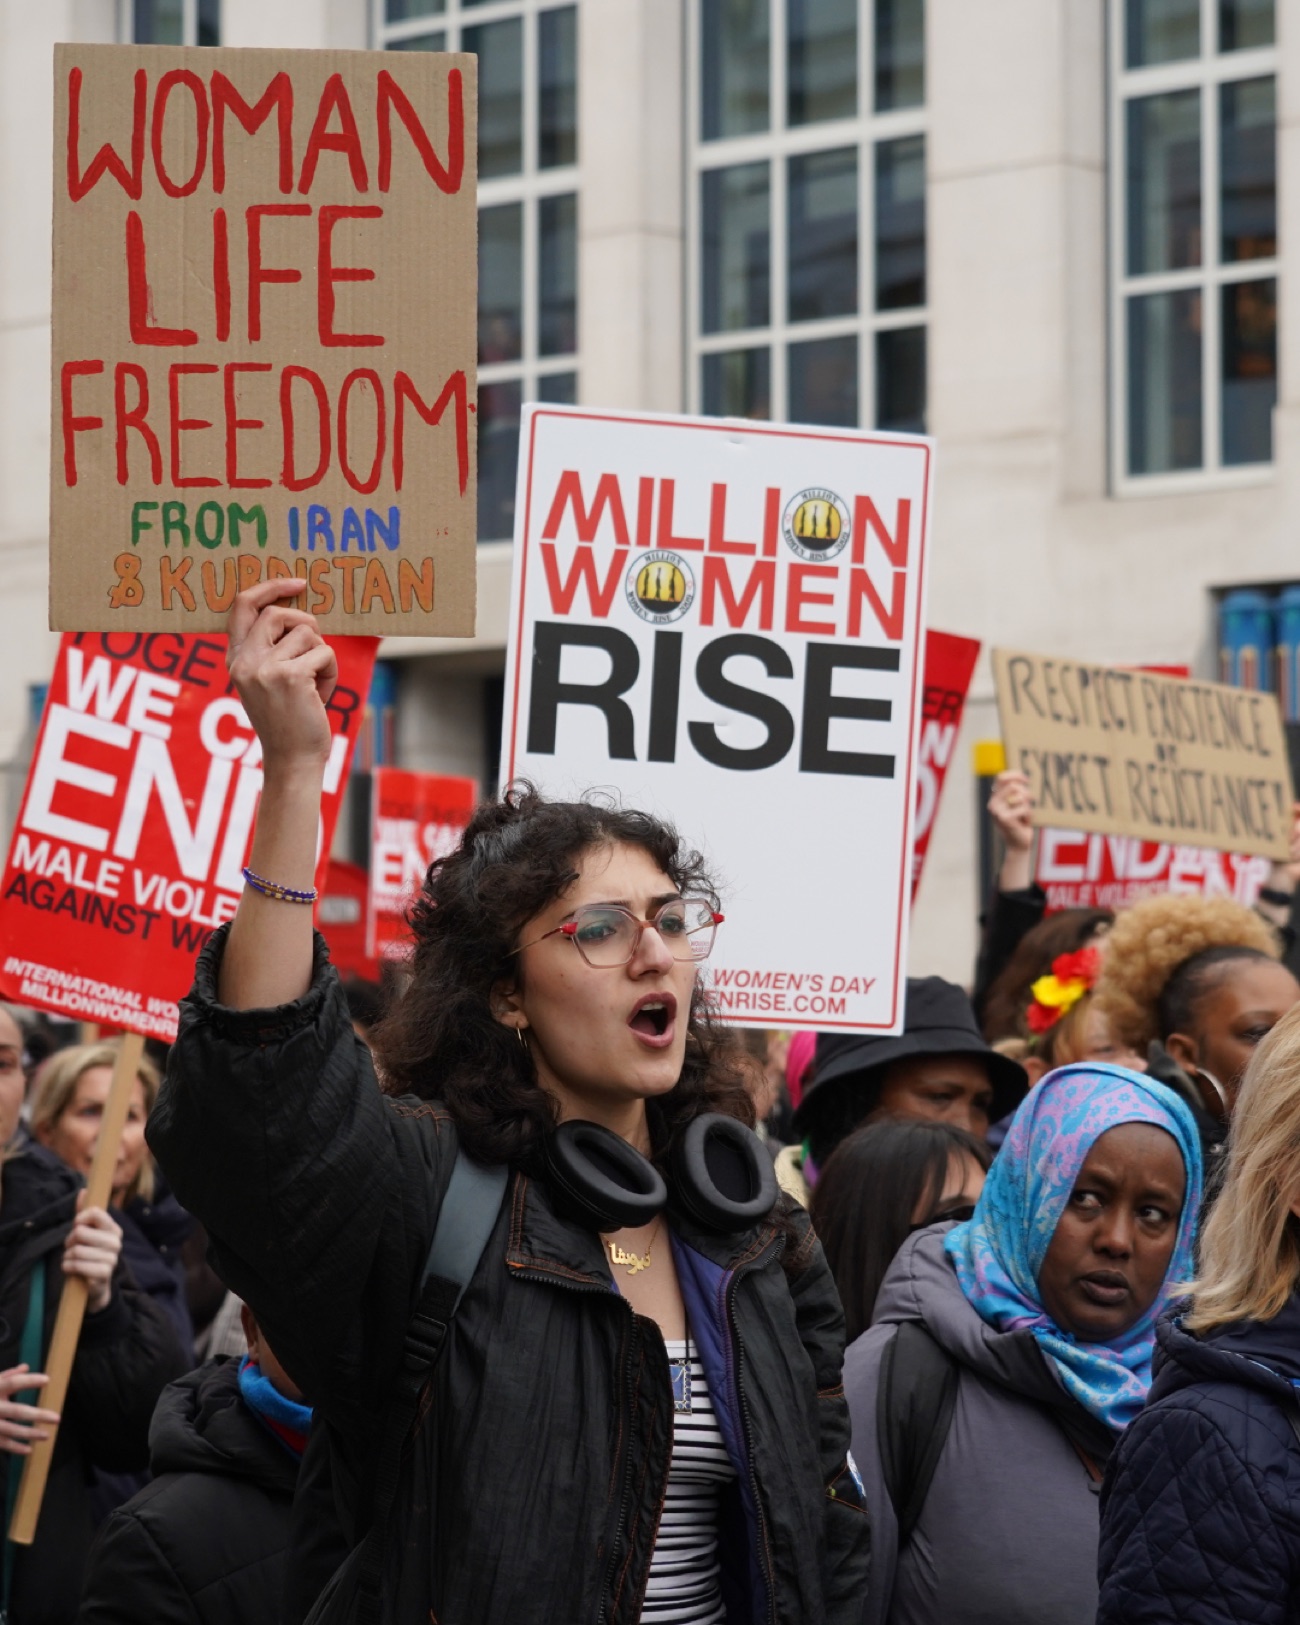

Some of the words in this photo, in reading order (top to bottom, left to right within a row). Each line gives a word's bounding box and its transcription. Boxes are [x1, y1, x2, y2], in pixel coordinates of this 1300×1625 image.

[67, 66, 465, 202] WOMAN
[125, 203, 385, 347] LIFE
[61, 360, 470, 498] FREEDOM
[131, 501, 268, 549] FROM
[287, 505, 400, 552] IRAN
[107, 552, 144, 609] &
[66, 646, 182, 741] WE
[526, 620, 901, 779] RISE
[1008, 657, 1136, 733] RESPECT
[1140, 676, 1272, 758] EXISTENCE
[1019, 748, 1116, 818] EXPECT
[12, 833, 125, 898] MALE
[4, 873, 161, 940] AGAINST
[2, 956, 143, 1012] INTERNATIONAL
[713, 968, 824, 993] WOMEN'S
[829, 975, 876, 995] DAY
